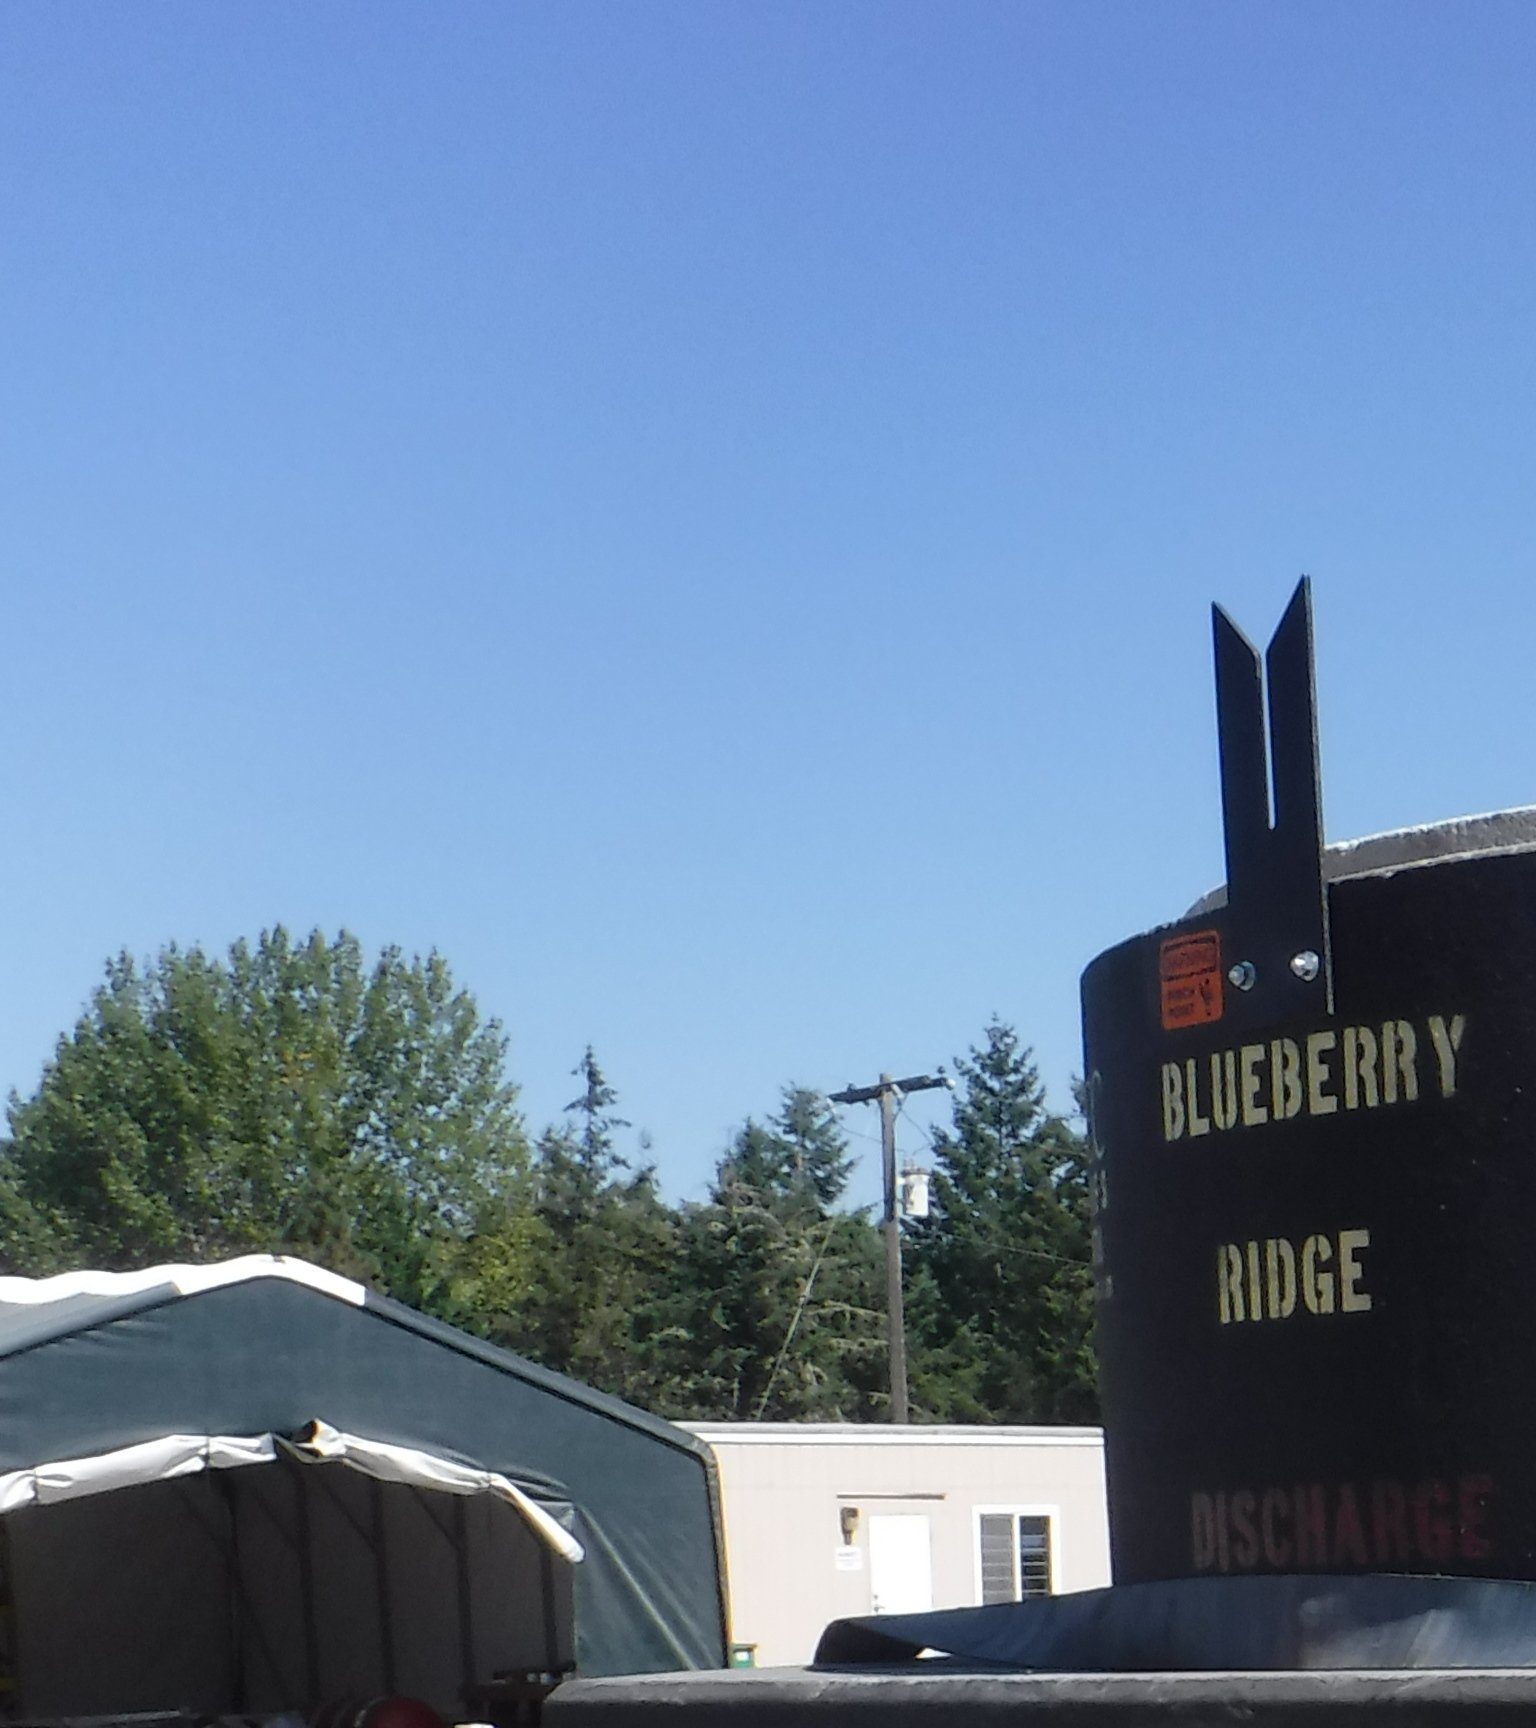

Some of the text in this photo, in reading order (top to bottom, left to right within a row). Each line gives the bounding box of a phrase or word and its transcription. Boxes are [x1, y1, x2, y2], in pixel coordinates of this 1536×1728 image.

[1162, 1015, 1465, 1141] BLUEBERRY
[1216, 1229, 1374, 1325] RIDGE
[1191, 1474, 1493, 1573] DISCHARGE
